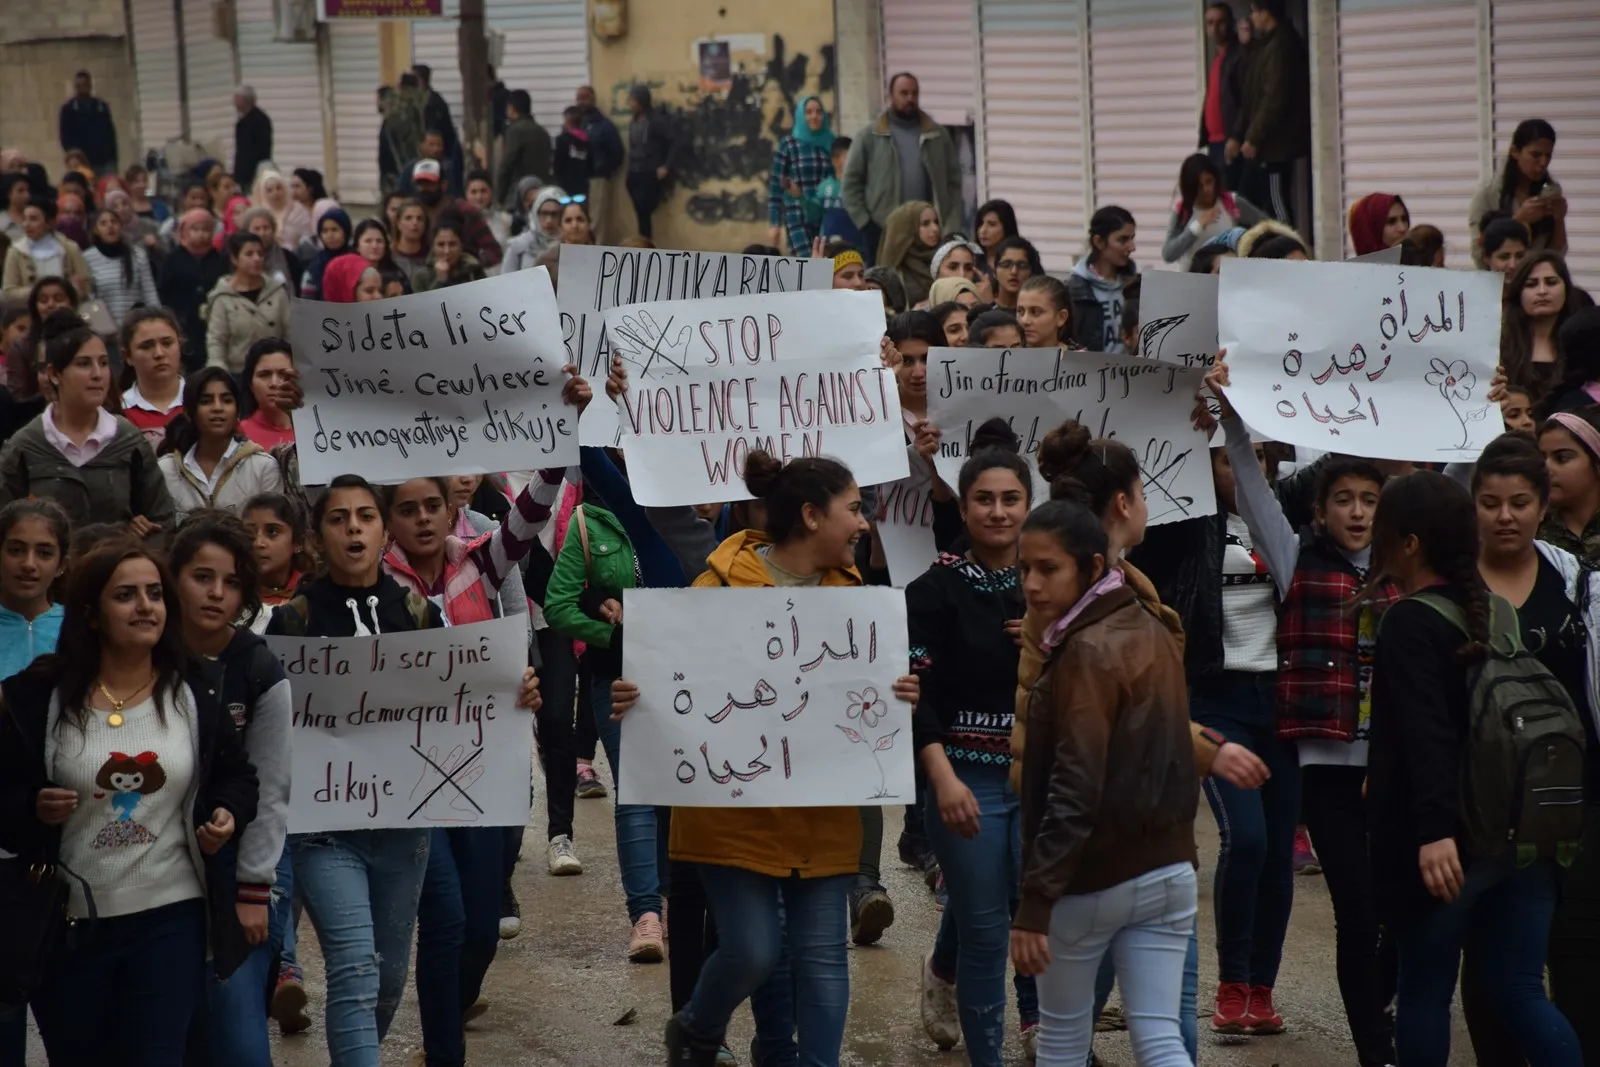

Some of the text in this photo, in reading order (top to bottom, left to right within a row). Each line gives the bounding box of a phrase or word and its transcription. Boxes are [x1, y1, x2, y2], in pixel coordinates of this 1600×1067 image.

[440, 302, 468, 345] li
[1380, 272, 1464, 343] المرأة
[699, 313, 783, 367] STOP
[1283, 332, 1391, 385] زهرة
[415, 357, 550, 396] Cewherê
[940, 359, 973, 398] Jin
[980, 349, 1088, 394] afrandina
[482, 400, 572, 453] dikuje
[621, 367, 889, 437] VIOLENCE AGAINST
[1272, 383, 1380, 435] الحياة
[279, 636, 491, 681] ideta li ser jinê
[766, 598, 877, 673] المرأة
[673, 671, 810, 724] زهرة
[313, 760, 394, 819] dikuje
[673, 734, 792, 799] الحياة
